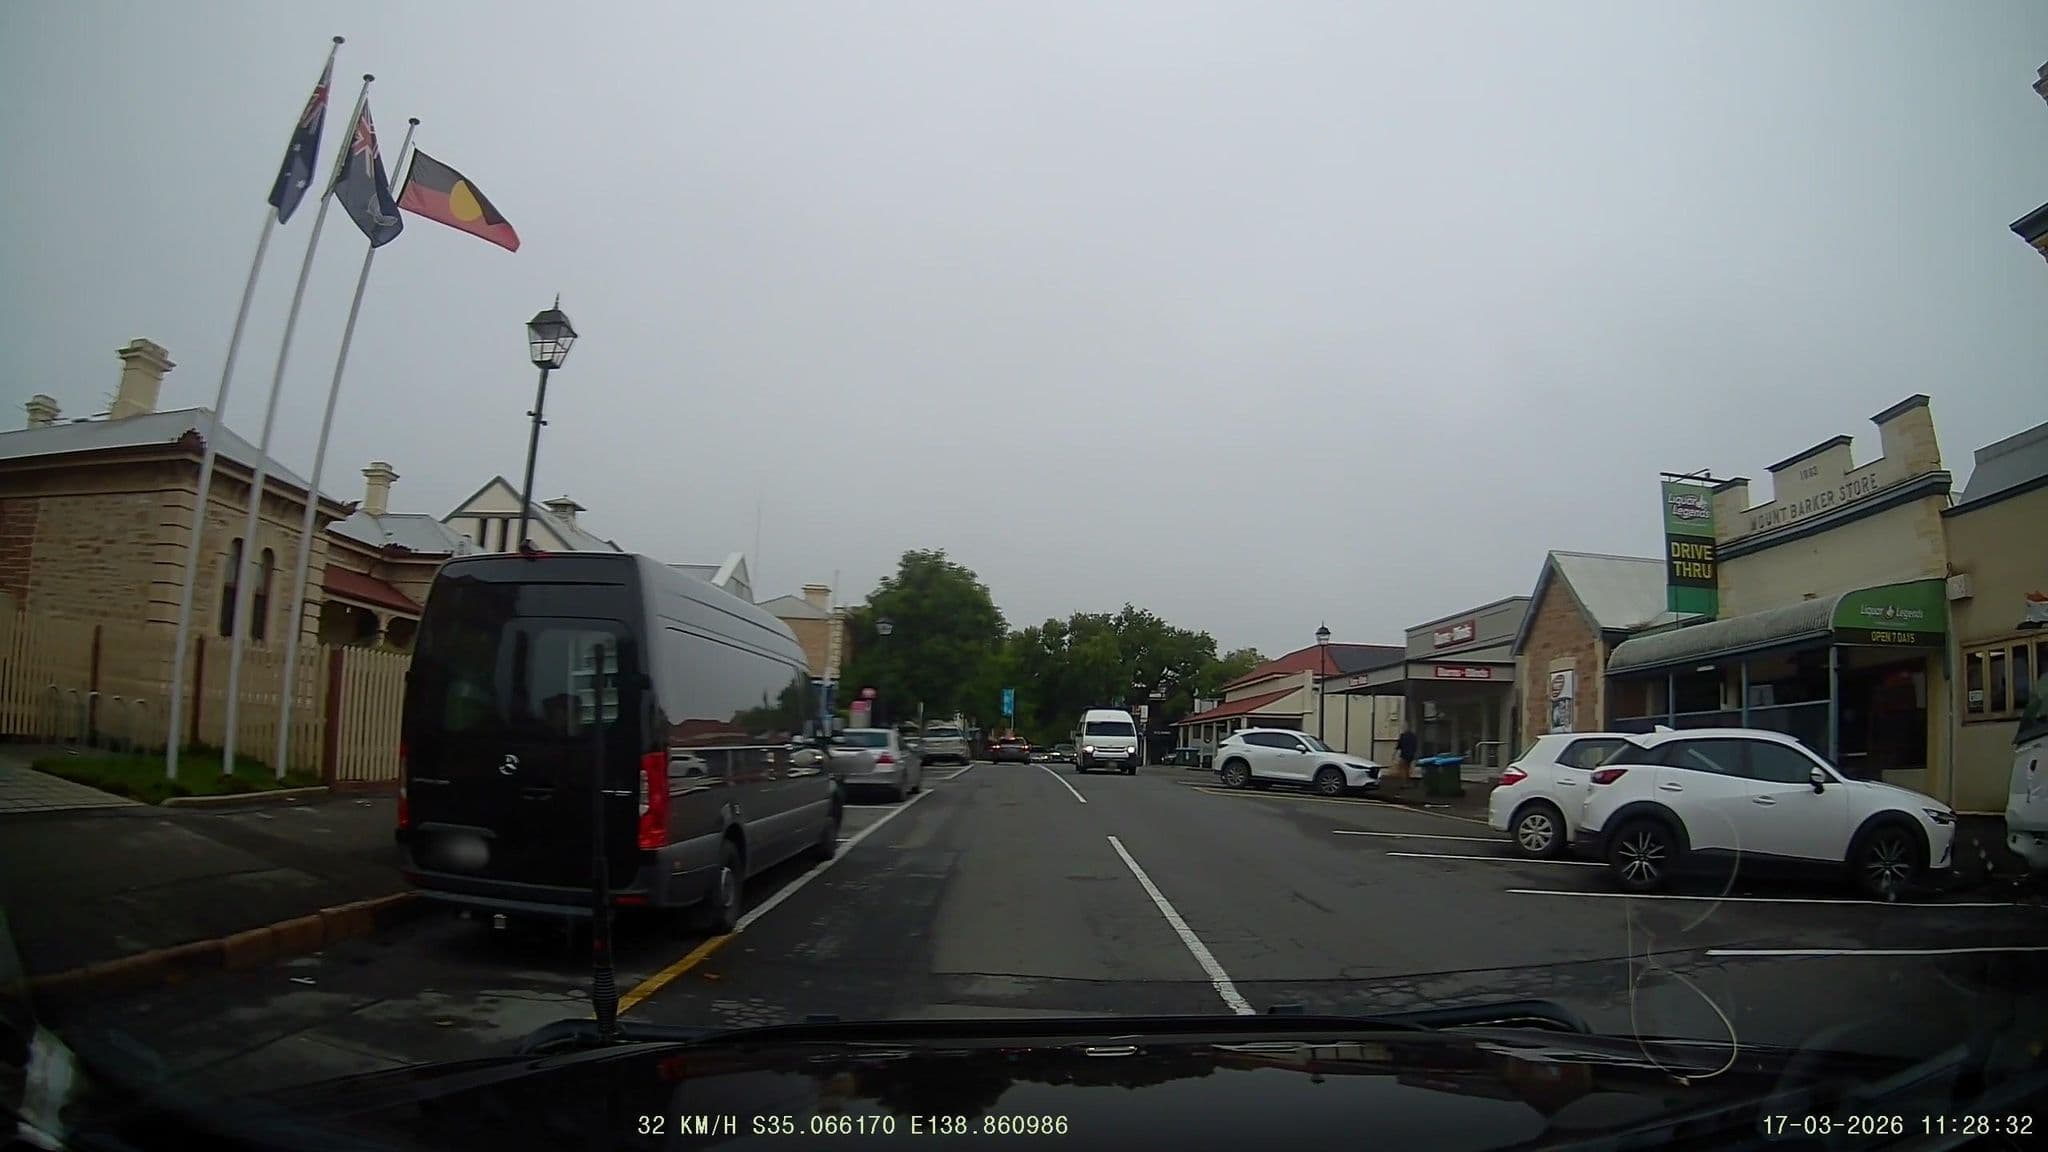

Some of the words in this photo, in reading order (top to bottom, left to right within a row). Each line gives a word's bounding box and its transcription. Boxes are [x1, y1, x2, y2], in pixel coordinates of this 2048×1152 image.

[1667, 493, 1697, 508] Liquor
[1750, 507, 1787, 531] MOUNT
[1790, 491, 1834, 519] BARKER
[1839, 473, 1878, 501] STORE
[1672, 504, 1711, 519] Legends
[1671, 541, 1713, 560] DRIVE
[1672, 561, 1711, 578] THRU
[1871, 631, 1891, 642] OPEN
[1897, 632, 1915, 643] DAYS
